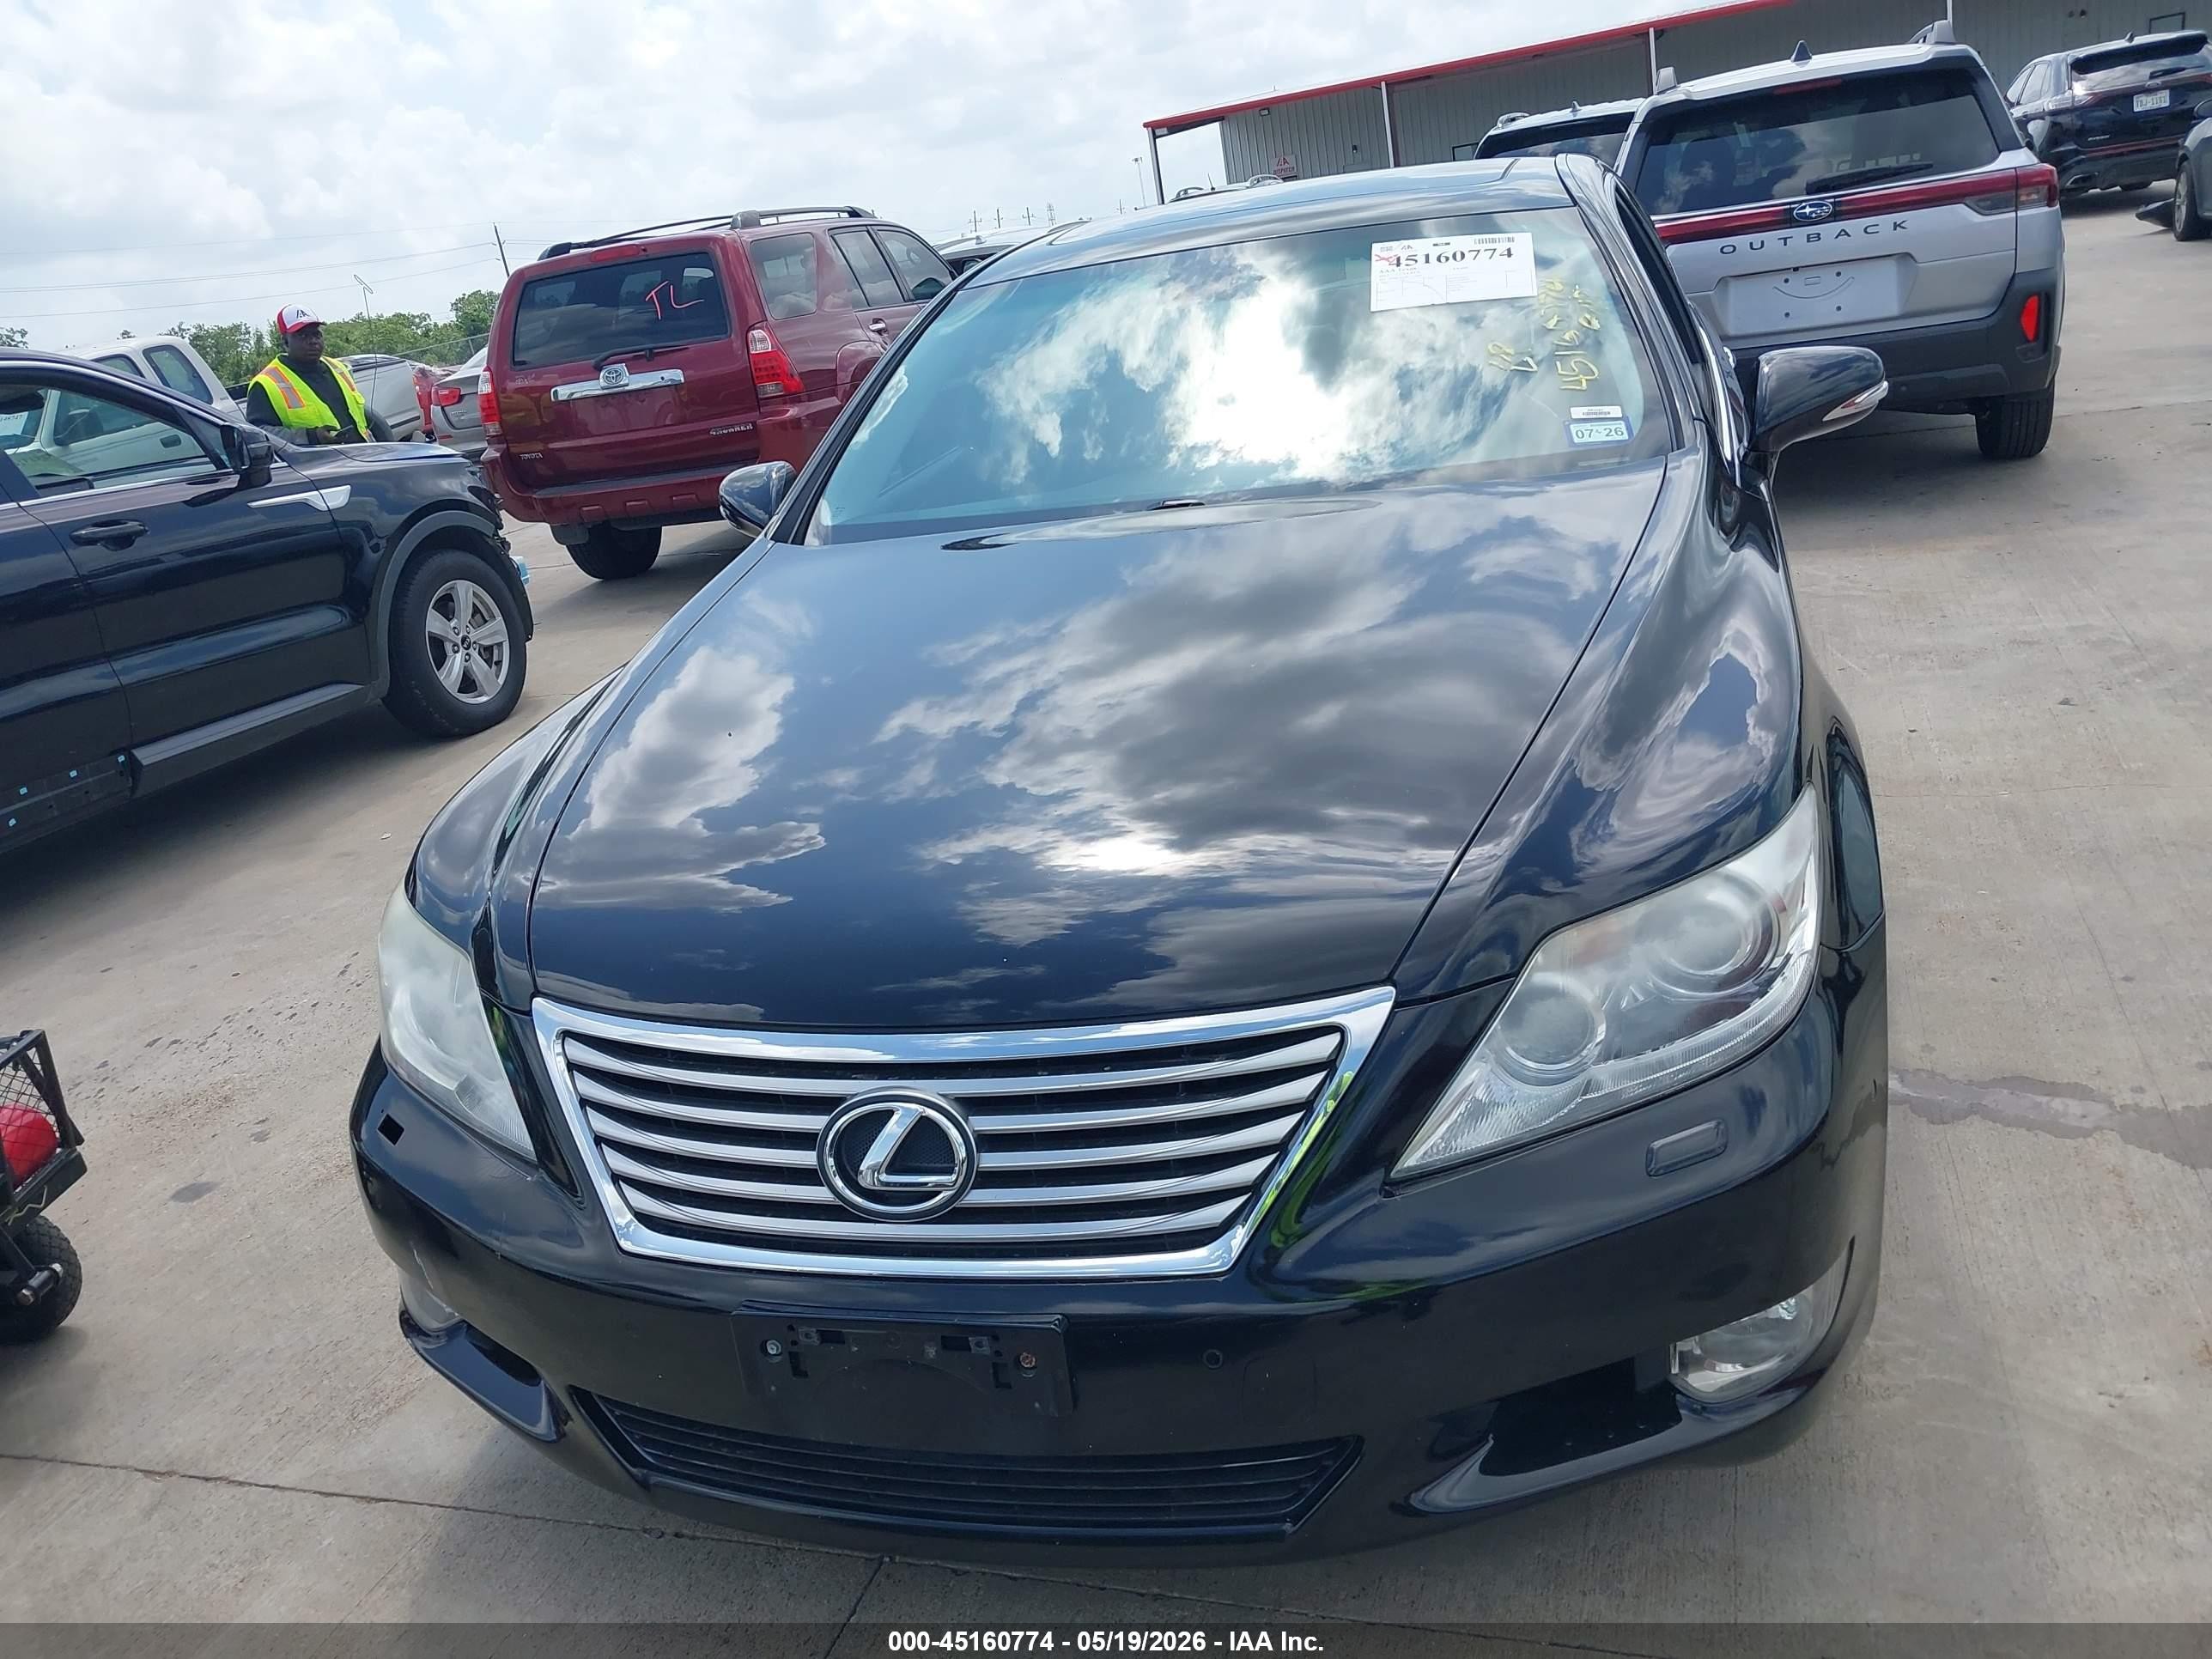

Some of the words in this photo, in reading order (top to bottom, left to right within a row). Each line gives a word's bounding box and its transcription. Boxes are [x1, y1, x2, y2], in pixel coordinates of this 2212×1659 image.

[1719, 220, 1908, 254] OUTBACK
[1388, 246, 1514, 268] 45160774
[645, 280, 705, 320] TL
[1575, 429, 1594, 440] 07
[1603, 427, 1625, 437] 26
